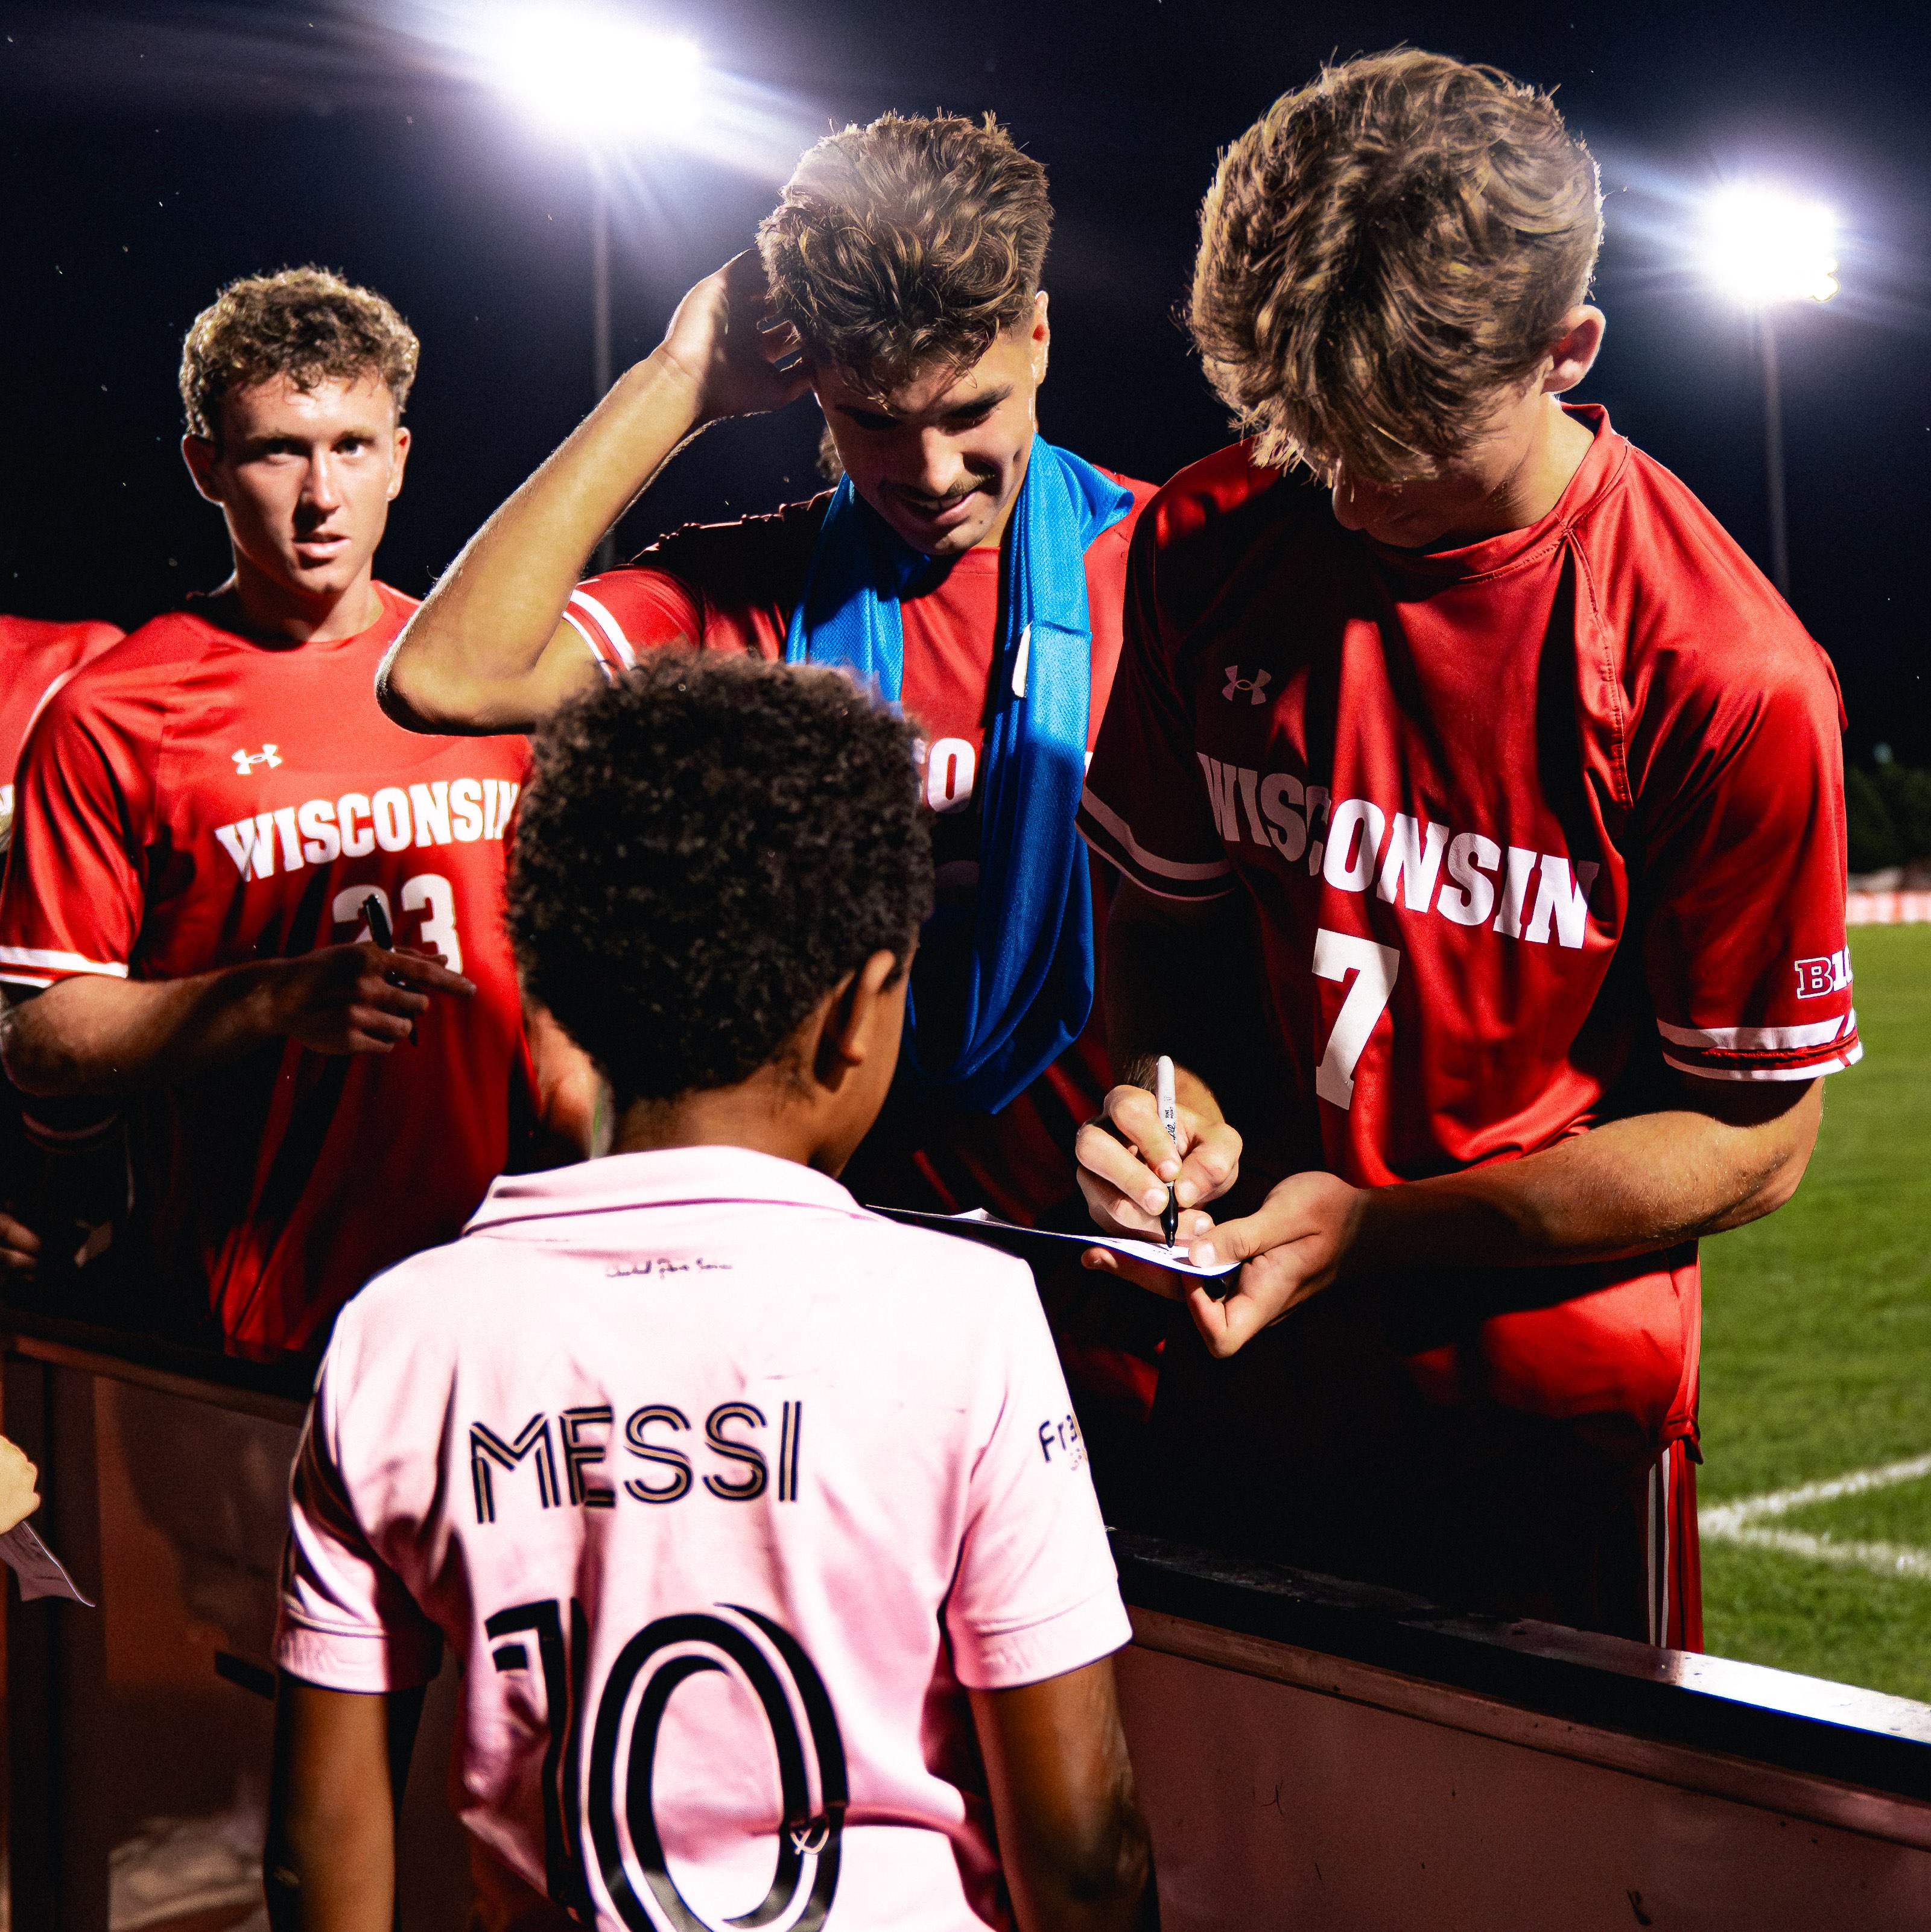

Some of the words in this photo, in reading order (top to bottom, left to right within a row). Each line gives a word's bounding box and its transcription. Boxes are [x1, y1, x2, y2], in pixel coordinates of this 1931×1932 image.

[1311, 928, 1400, 1110] 7
[469, 1399, 803, 1524] MESSI
[484, 1595, 850, 1932] 10
